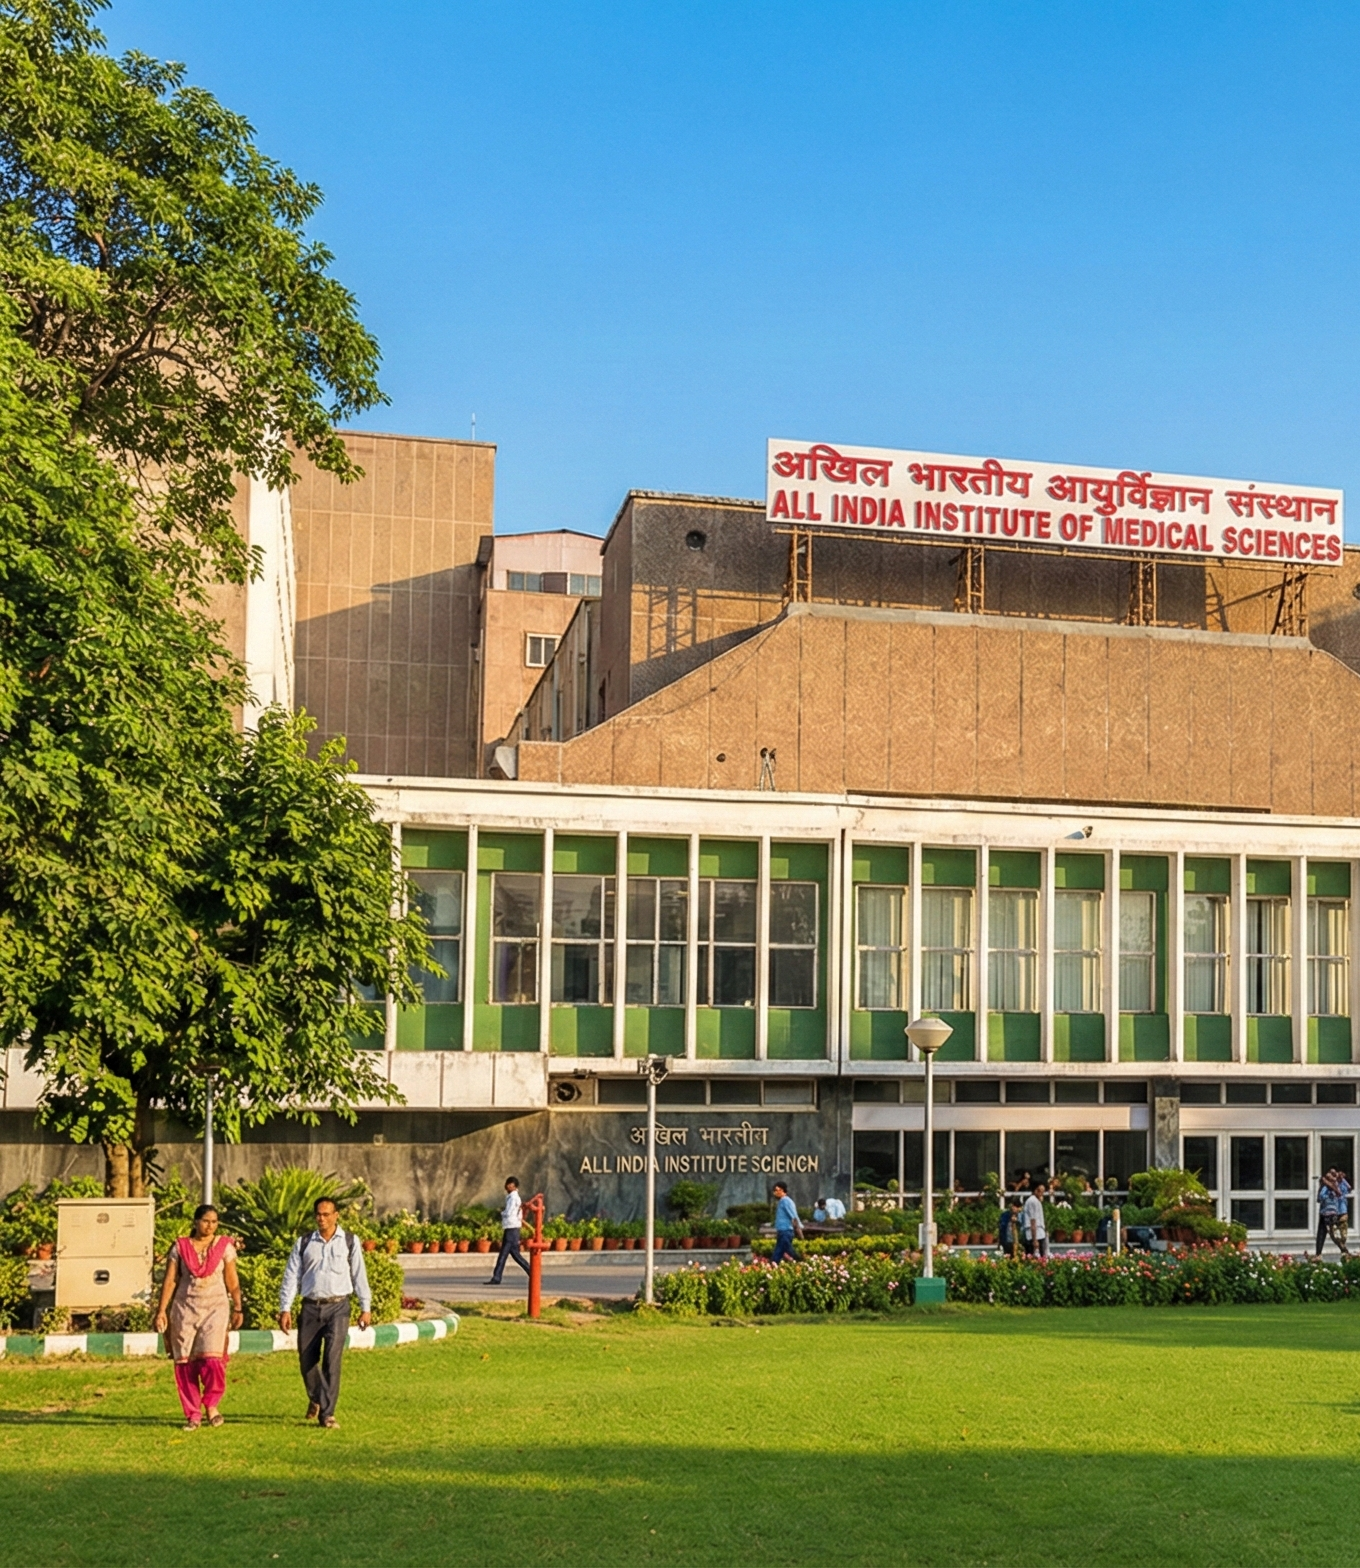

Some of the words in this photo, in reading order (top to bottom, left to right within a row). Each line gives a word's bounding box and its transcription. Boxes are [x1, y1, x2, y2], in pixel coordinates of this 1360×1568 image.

[772, 444, 893, 488] अखिल
[907, 458, 1033, 498] भारतीय
[1046, 470, 1213, 516] आयुर्विज्ञान
[1225, 484, 1338, 525] संस्थान
[769, 489, 822, 521] ALL
[831, 493, 906, 528] INDIA
[914, 500, 1052, 540] INSTITUTE
[1058, 512, 1093, 542] OF
[1101, 516, 1214, 552] MEDICAL
[1221, 525, 1342, 562] SCIENCES
[579, 1155, 613, 1174] ALL
[664, 1154, 748, 1173] INSTITUTE
